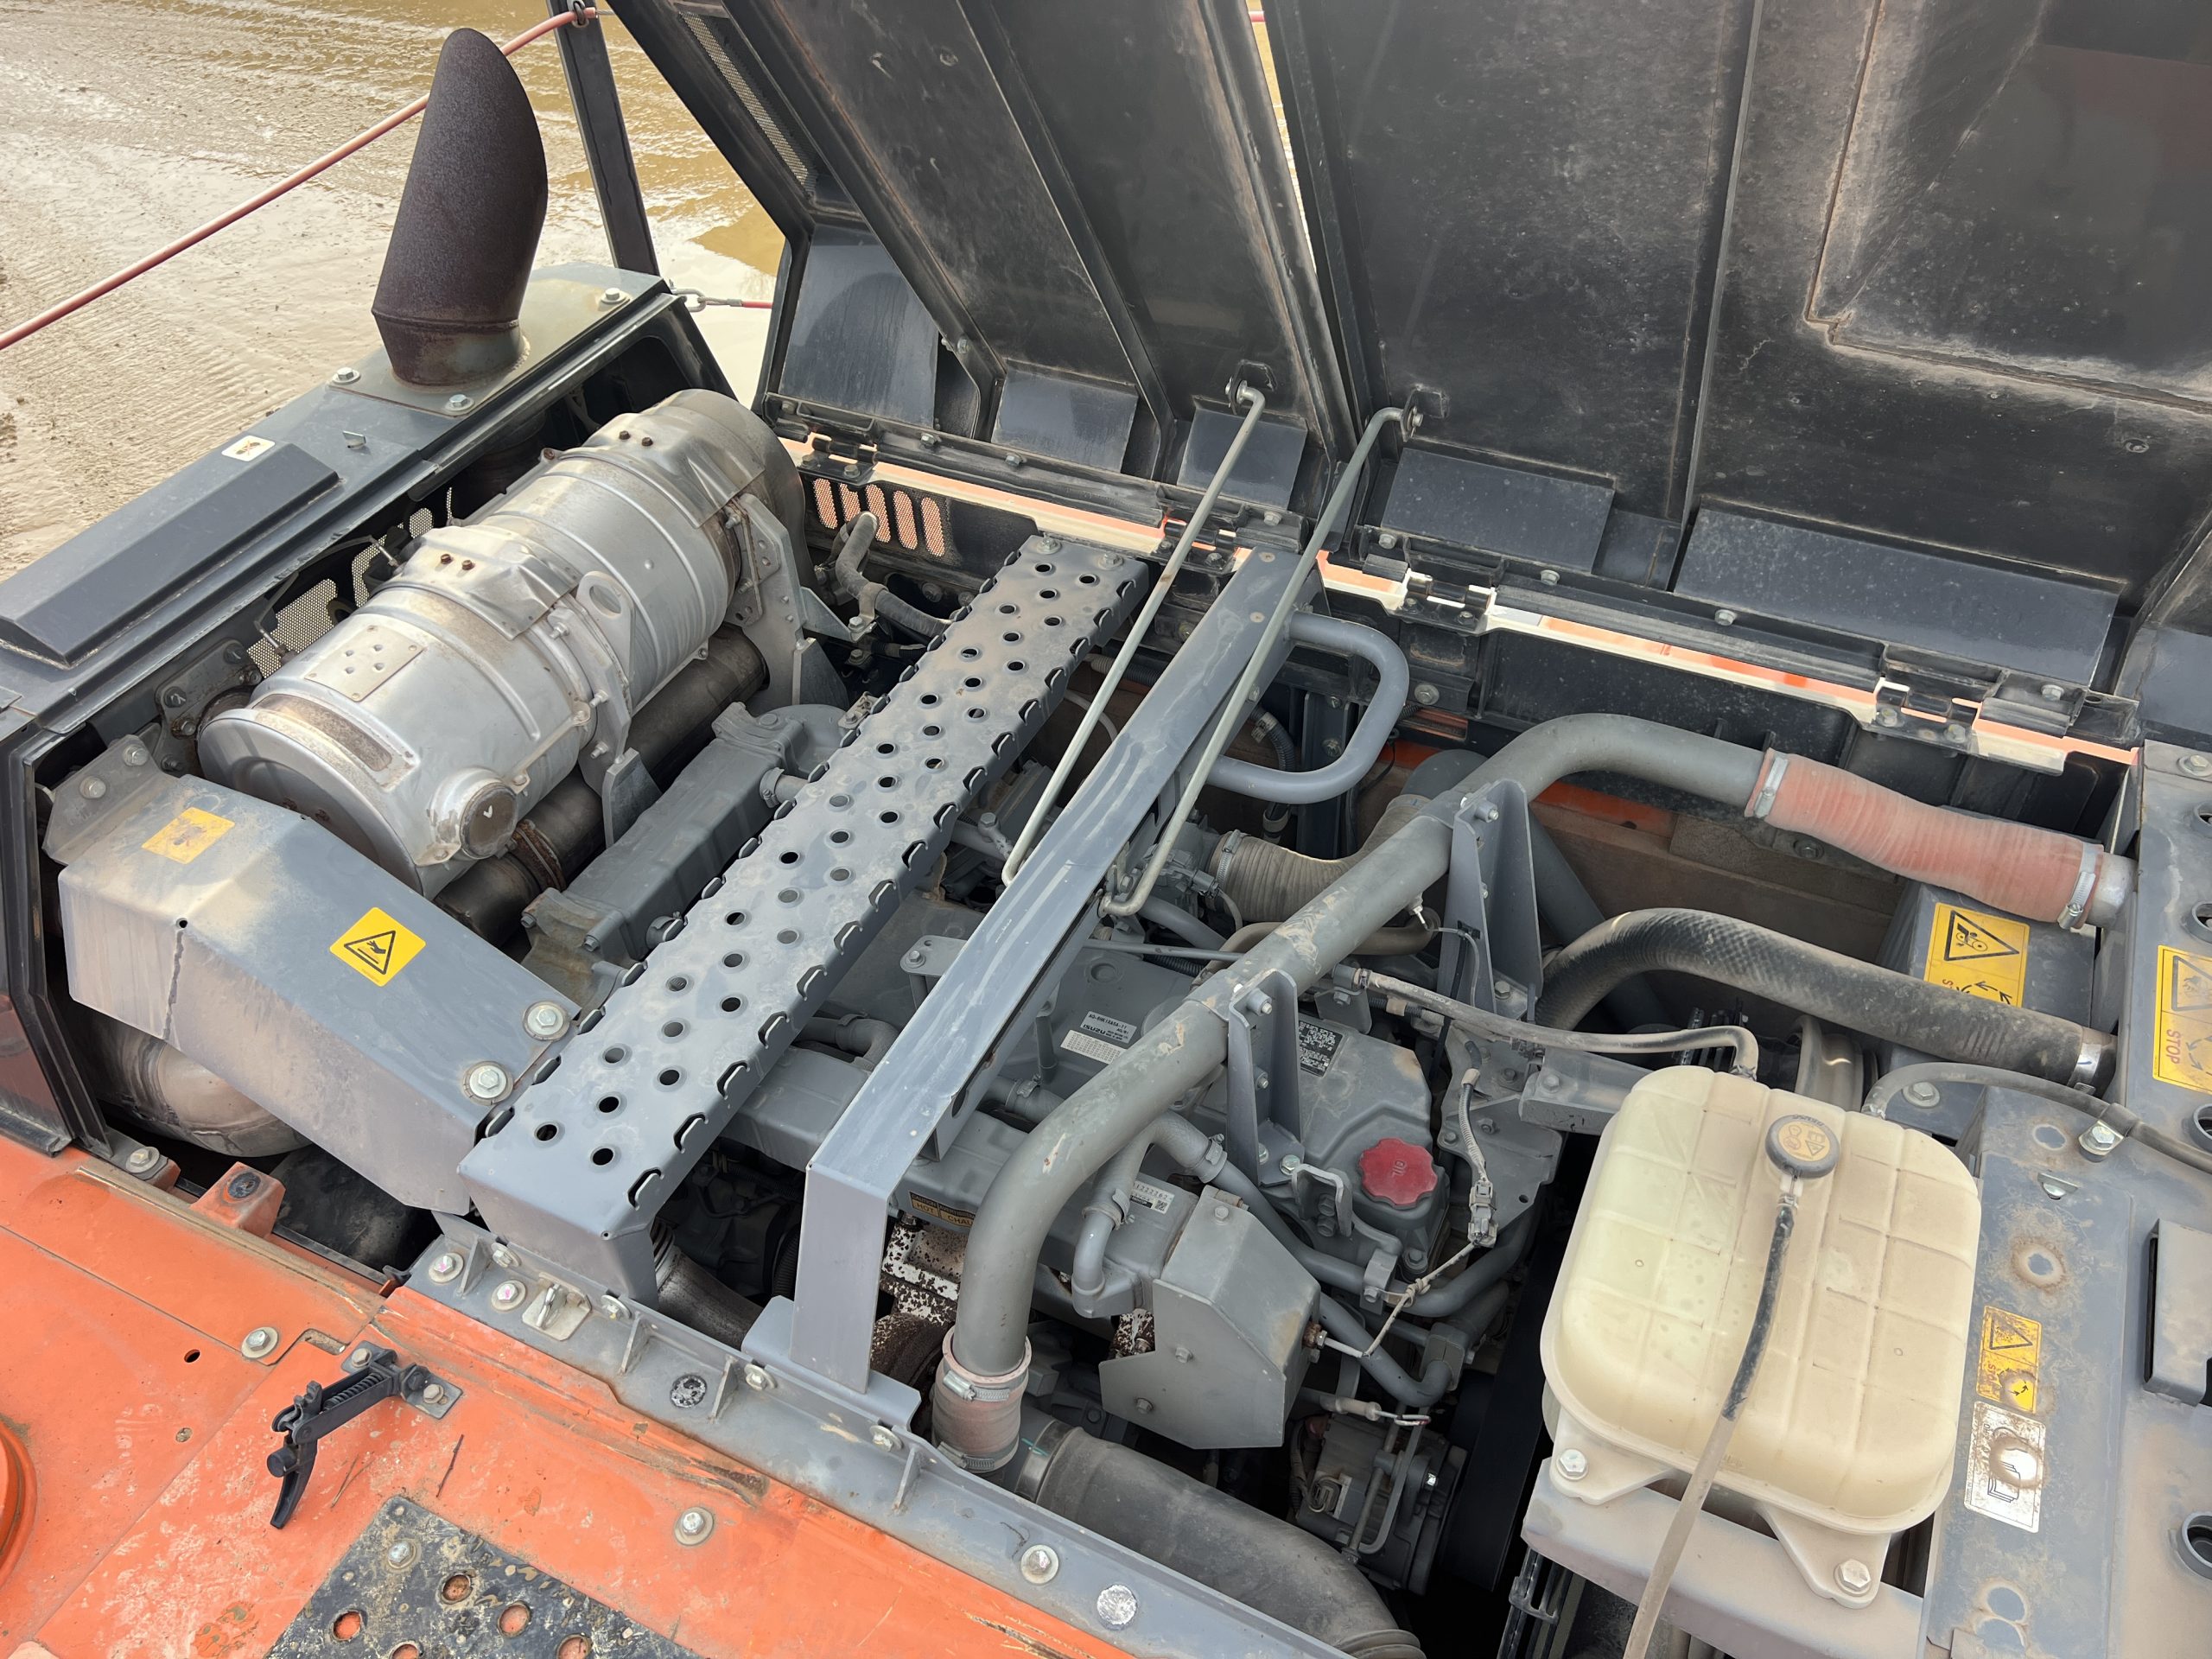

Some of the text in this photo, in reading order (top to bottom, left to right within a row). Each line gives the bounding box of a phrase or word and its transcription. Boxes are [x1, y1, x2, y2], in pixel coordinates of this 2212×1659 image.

[1083, 1024, 1106, 1034] ISUZU
[2165, 1029, 2181, 1064] STOP
[912, 1194, 937, 1207] CAUTION
[916, 1202, 973, 1225] HOT CHAU
